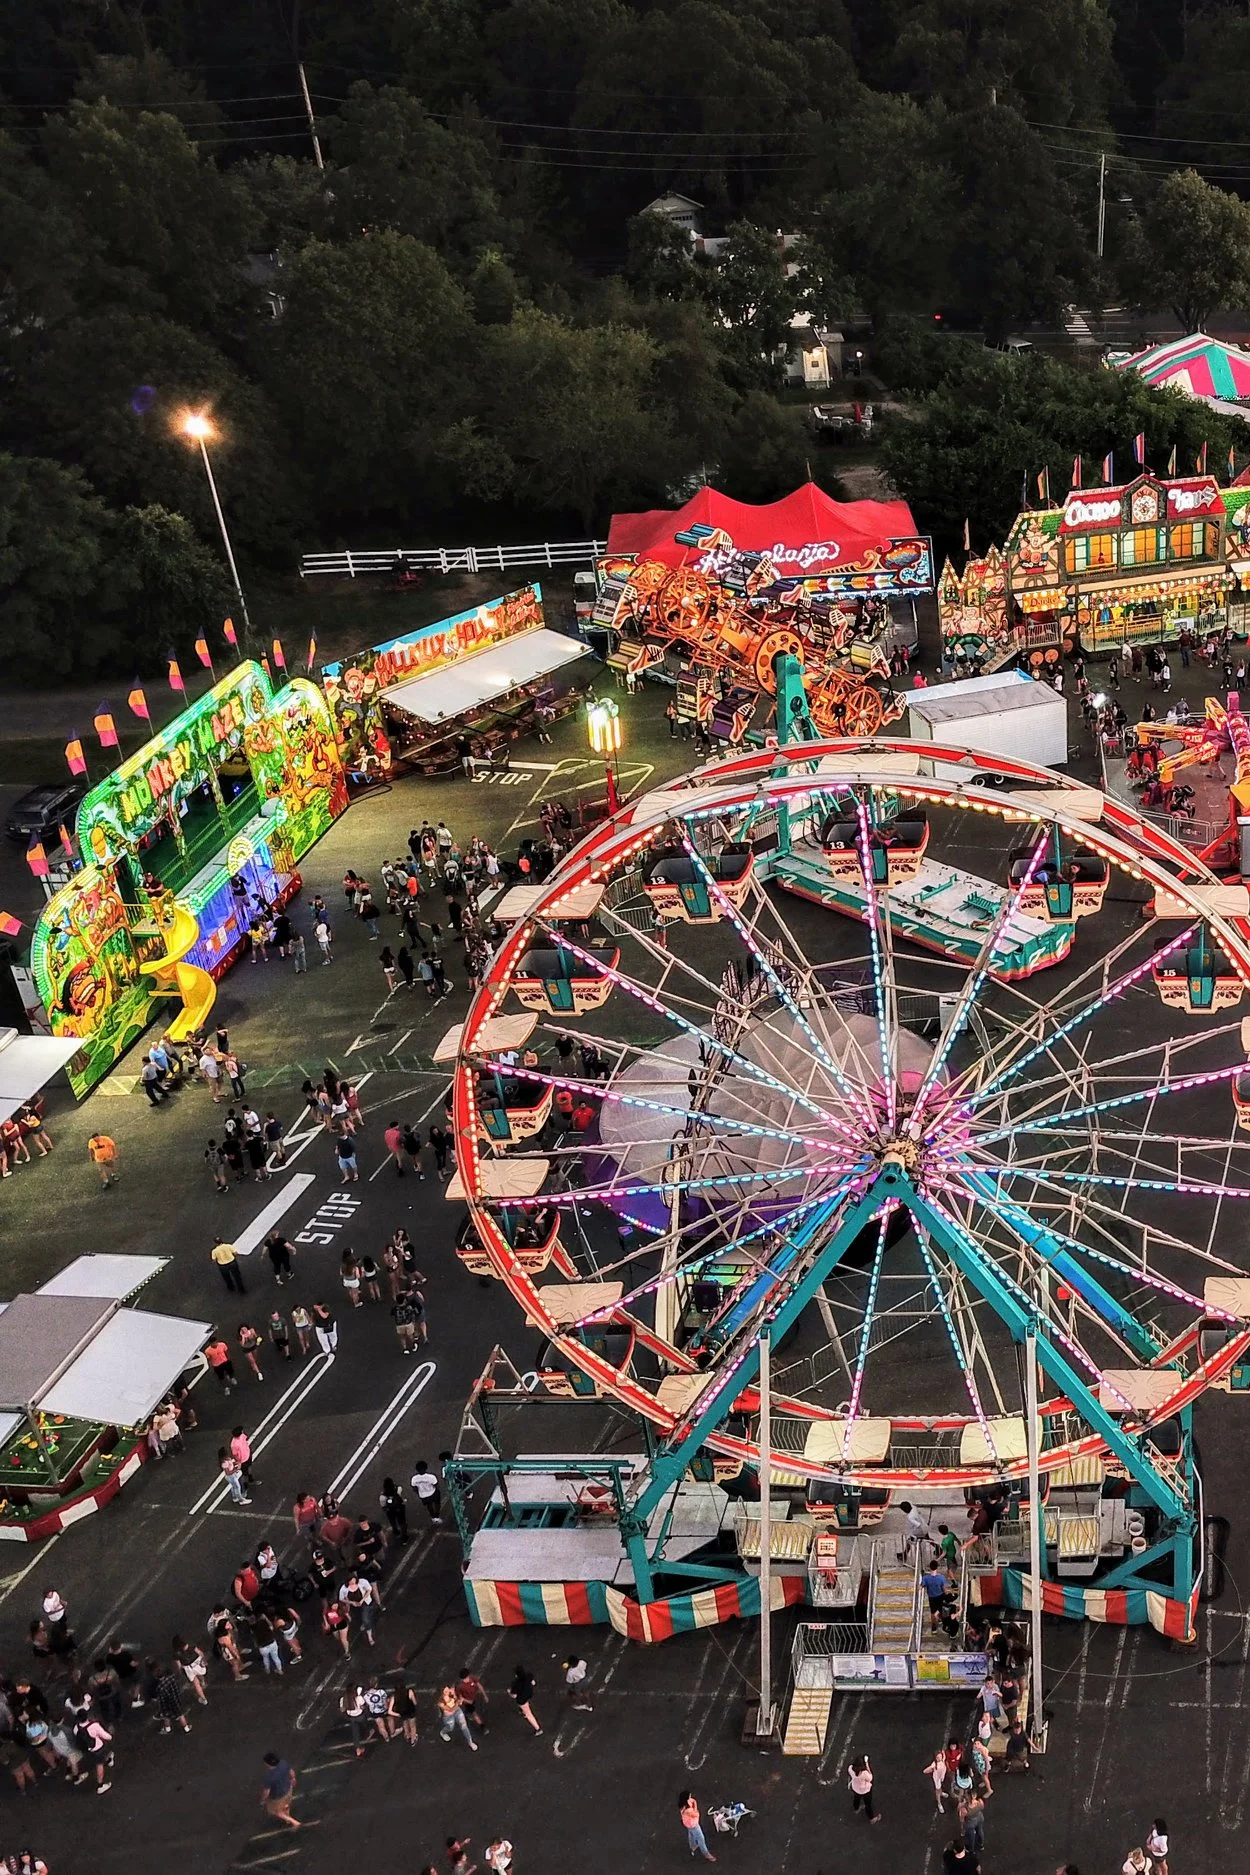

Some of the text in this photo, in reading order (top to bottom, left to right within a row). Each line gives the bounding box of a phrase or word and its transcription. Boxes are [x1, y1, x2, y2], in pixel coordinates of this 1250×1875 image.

[119, 694, 246, 824] MONKEY MAZE
[470, 770, 533, 786] STOP
[829, 841, 845, 850] 13
[650, 875, 666, 885] 12
[515, 970, 529, 979] 11
[1163, 969, 1176, 977] 15
[293, 1192, 362, 1245] STOP
